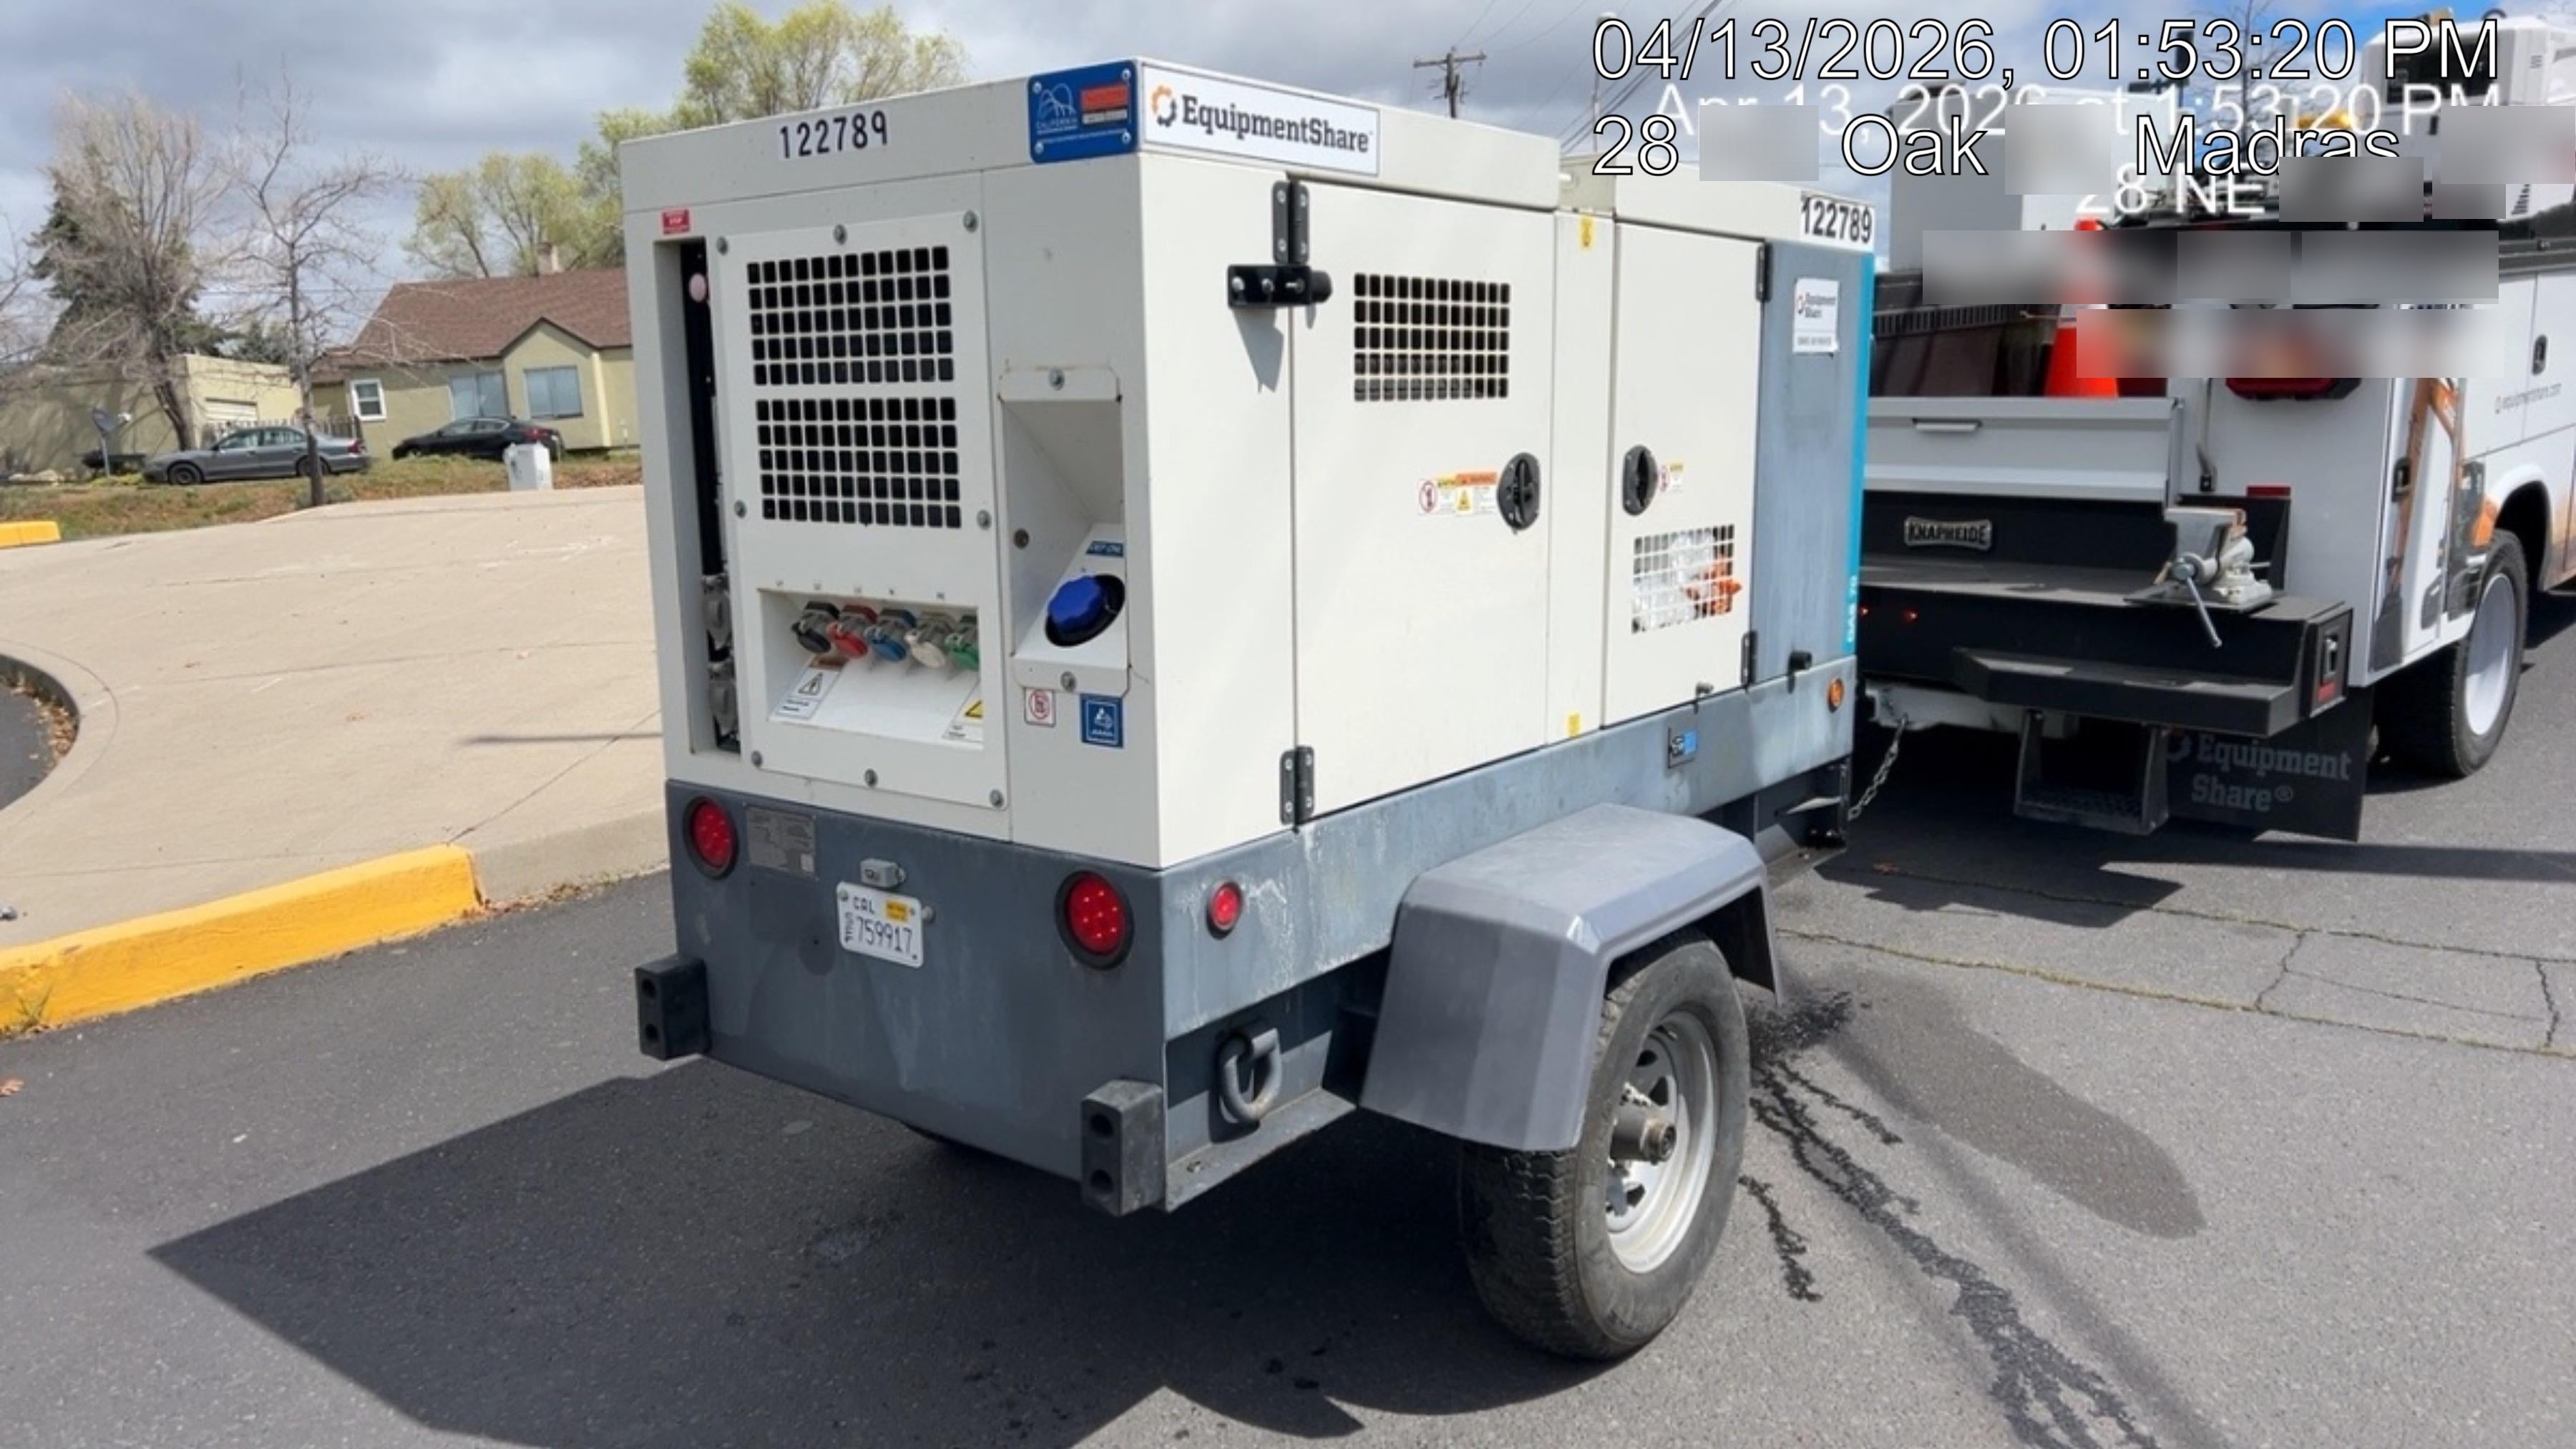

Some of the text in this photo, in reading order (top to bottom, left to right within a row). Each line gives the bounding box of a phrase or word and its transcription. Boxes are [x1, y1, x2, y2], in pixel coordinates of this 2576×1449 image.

[780, 110, 887, 159] 122789
[1181, 94, 1368, 154] EquipmentShare
[1801, 197, 1873, 244] 122789
[1909, 521, 1989, 546] KNAPHEIDE
[2196, 733, 2352, 781] Equipment
[857, 916, 912, 955] 759917
